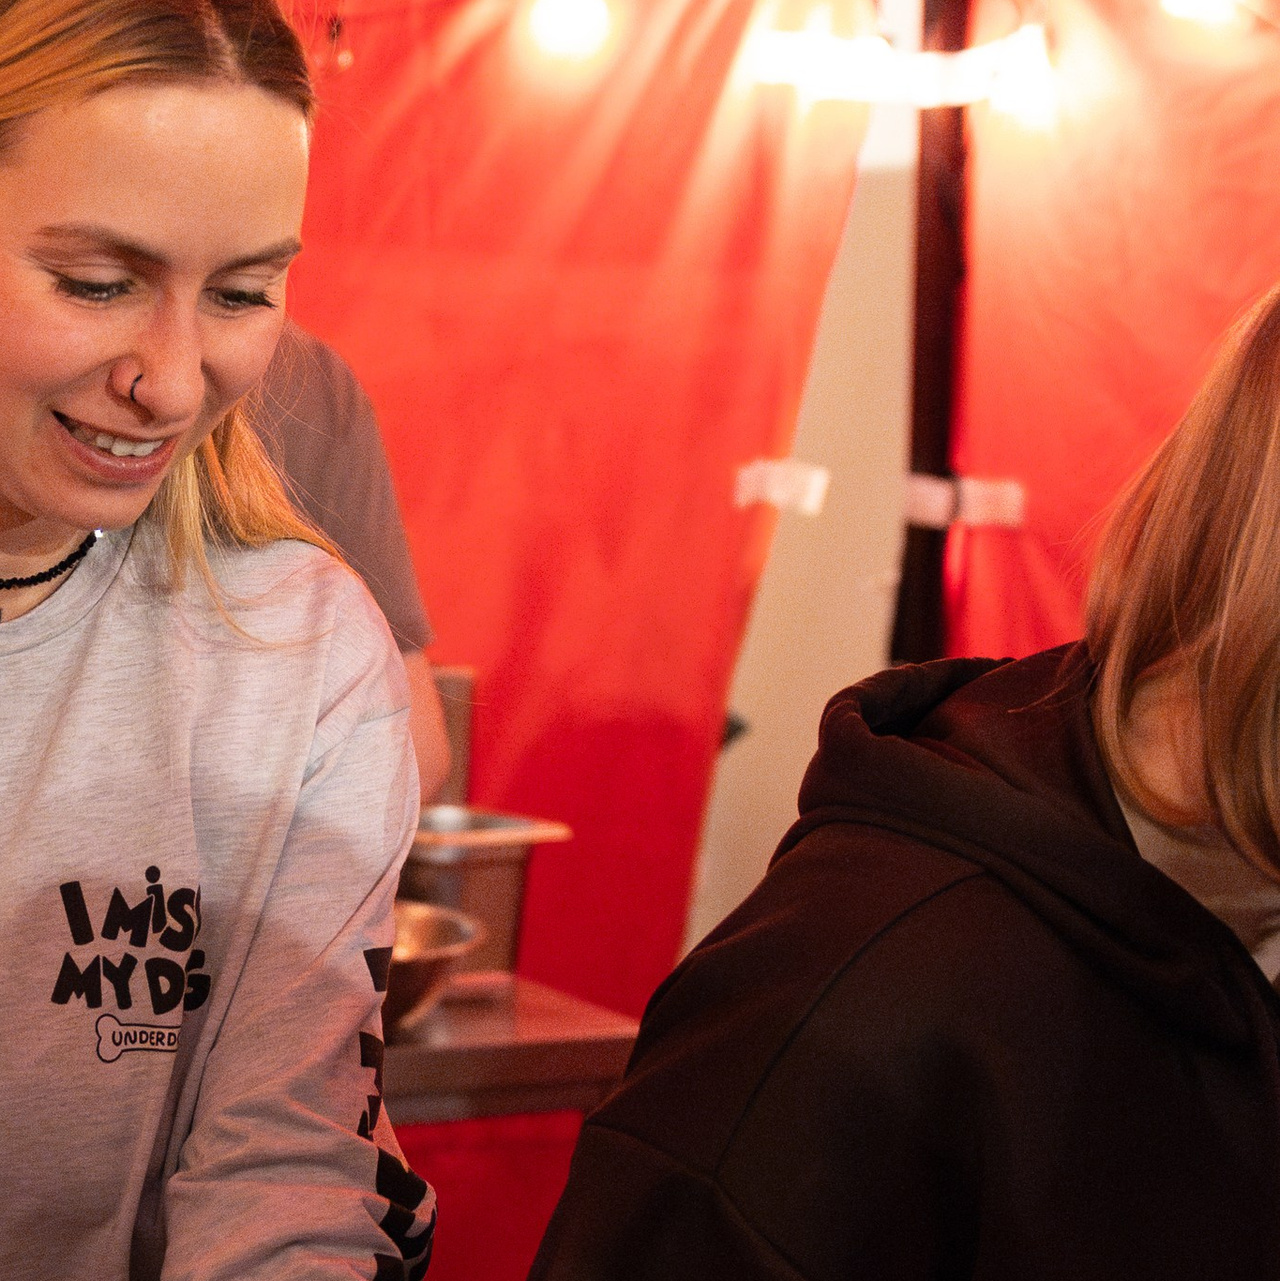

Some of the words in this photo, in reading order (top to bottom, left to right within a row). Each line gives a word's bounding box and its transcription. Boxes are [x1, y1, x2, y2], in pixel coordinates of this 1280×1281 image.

[59, 881, 95, 946] I
[101, 865, 202, 952] MiS
[50, 952, 138, 1010] MY
[144, 949, 211, 1016] DG
[111, 1029, 181, 1047] UNDERD
